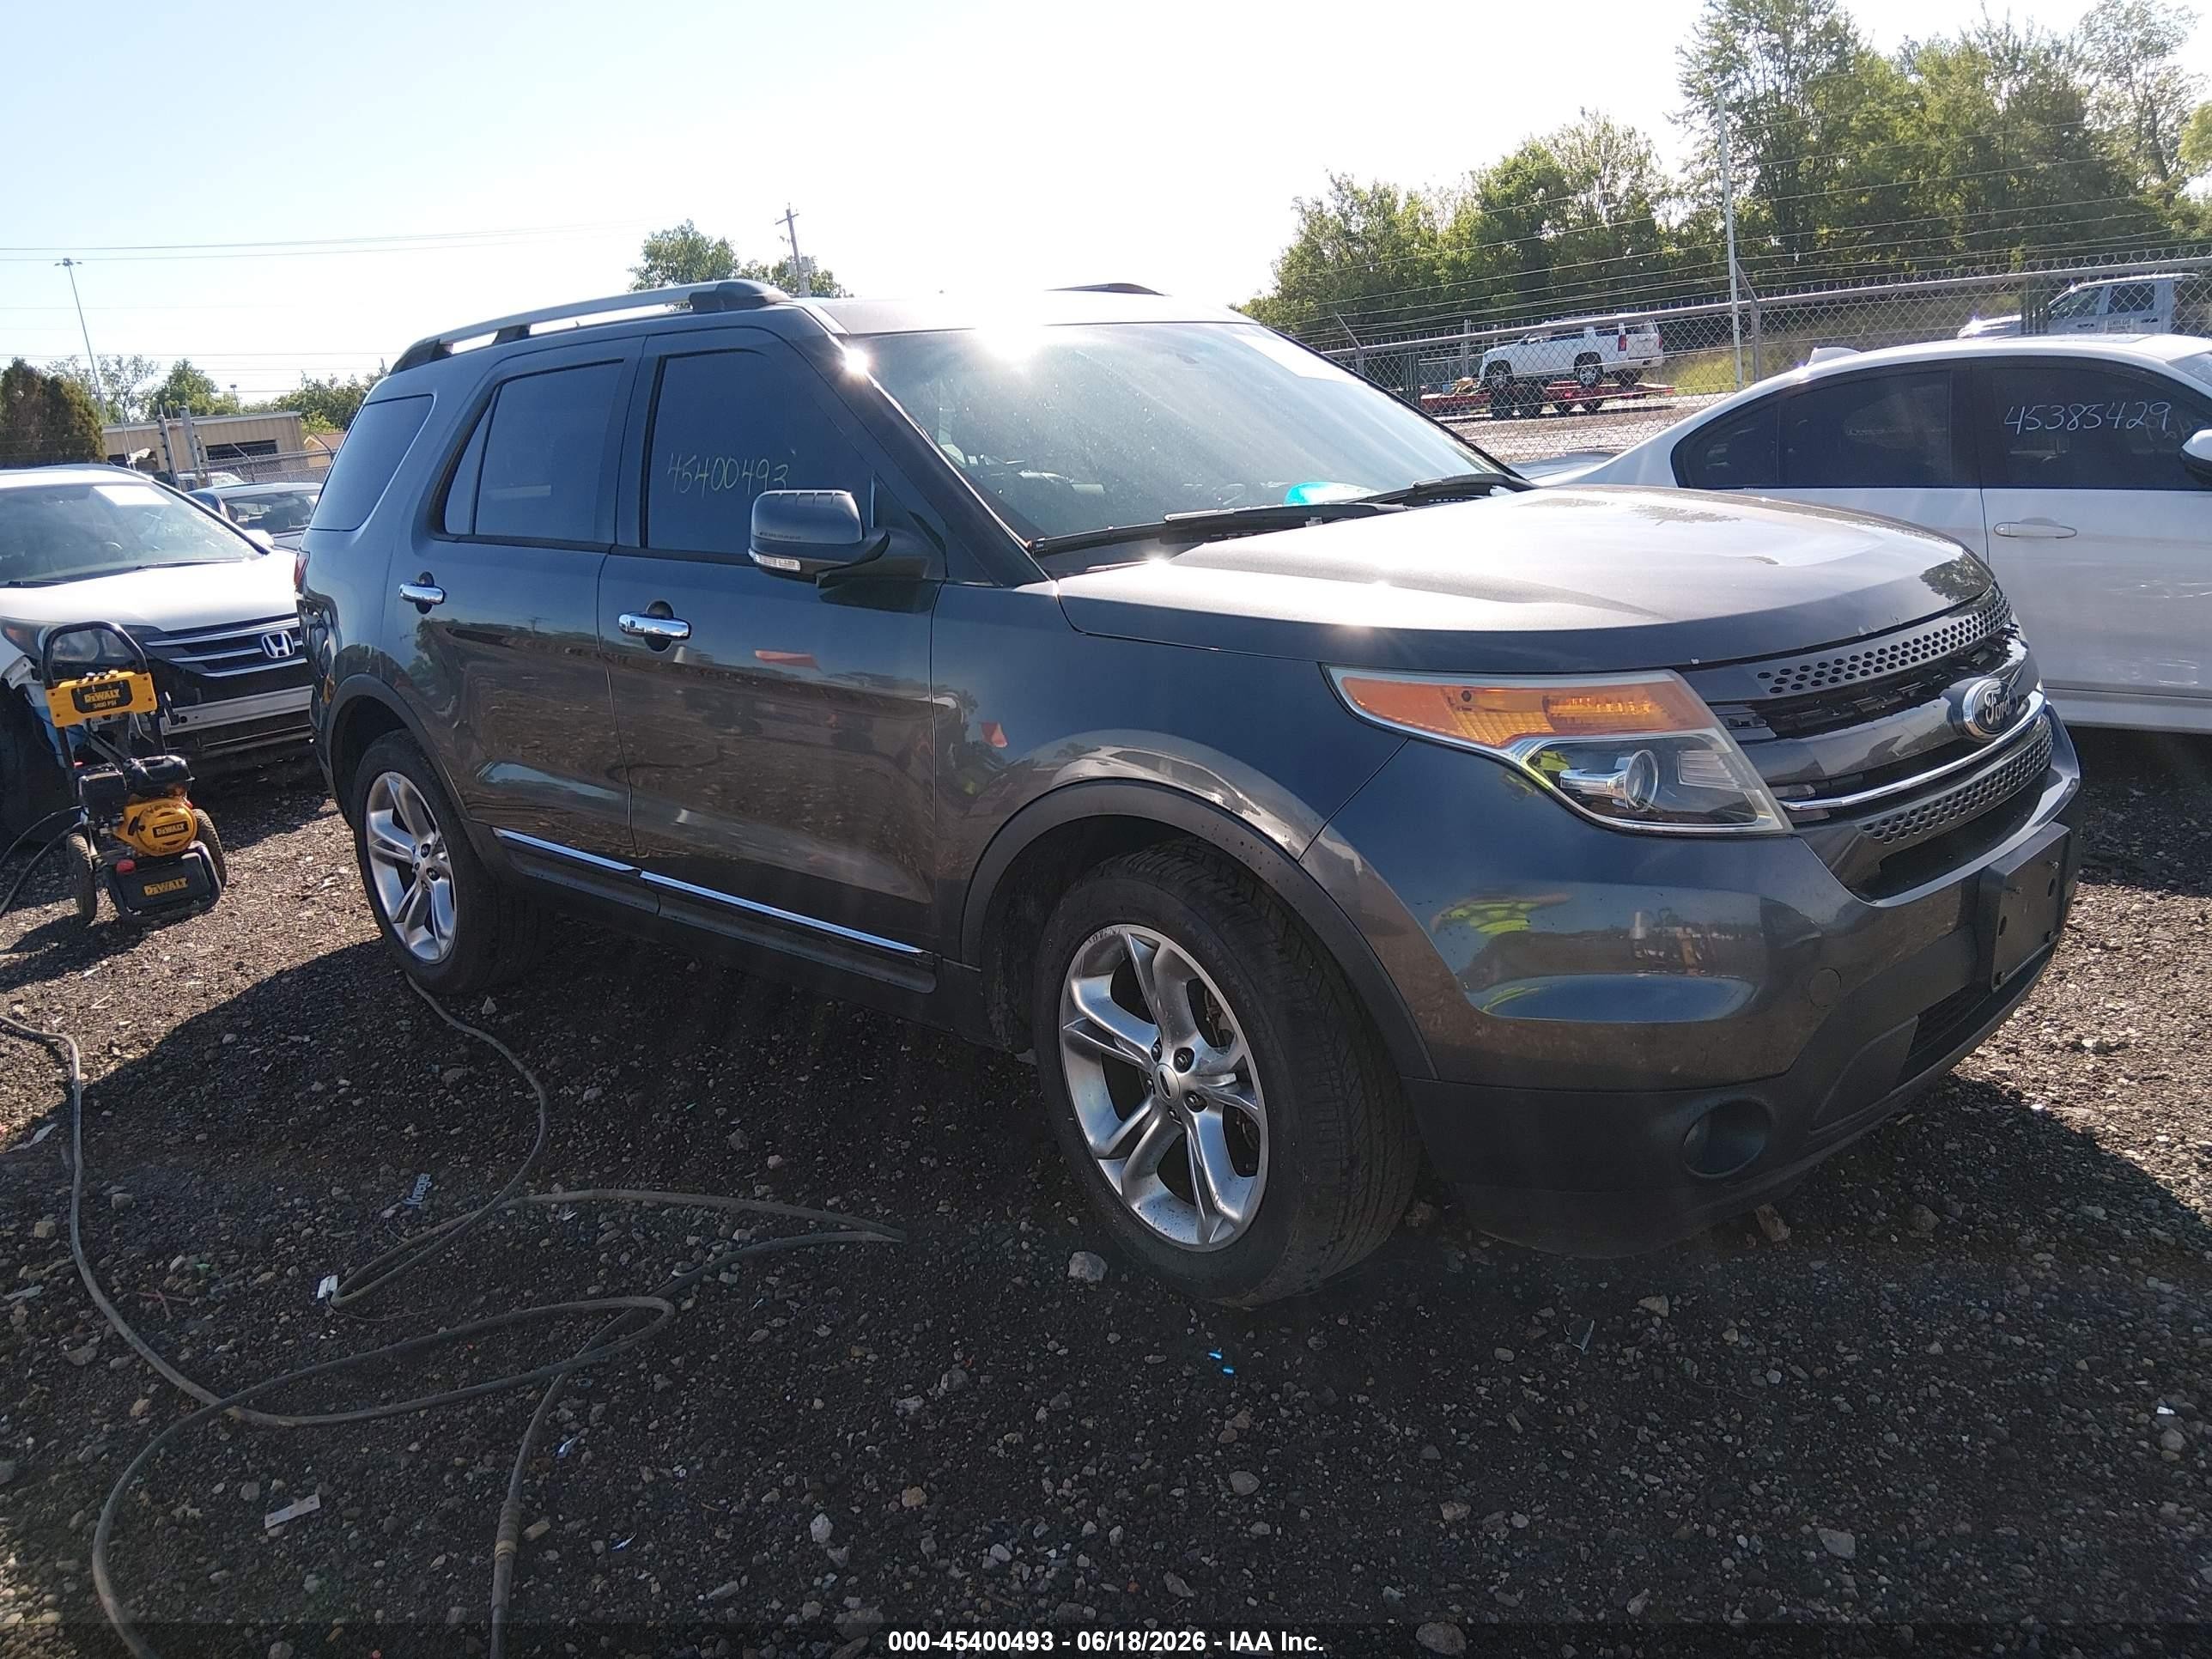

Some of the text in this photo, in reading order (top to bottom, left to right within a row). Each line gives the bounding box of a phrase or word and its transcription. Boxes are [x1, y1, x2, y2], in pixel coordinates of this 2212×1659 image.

[2003, 400, 2172, 435] 45385429
[667, 452, 789, 498] 45400493
[1984, 686, 2014, 725] Ford
